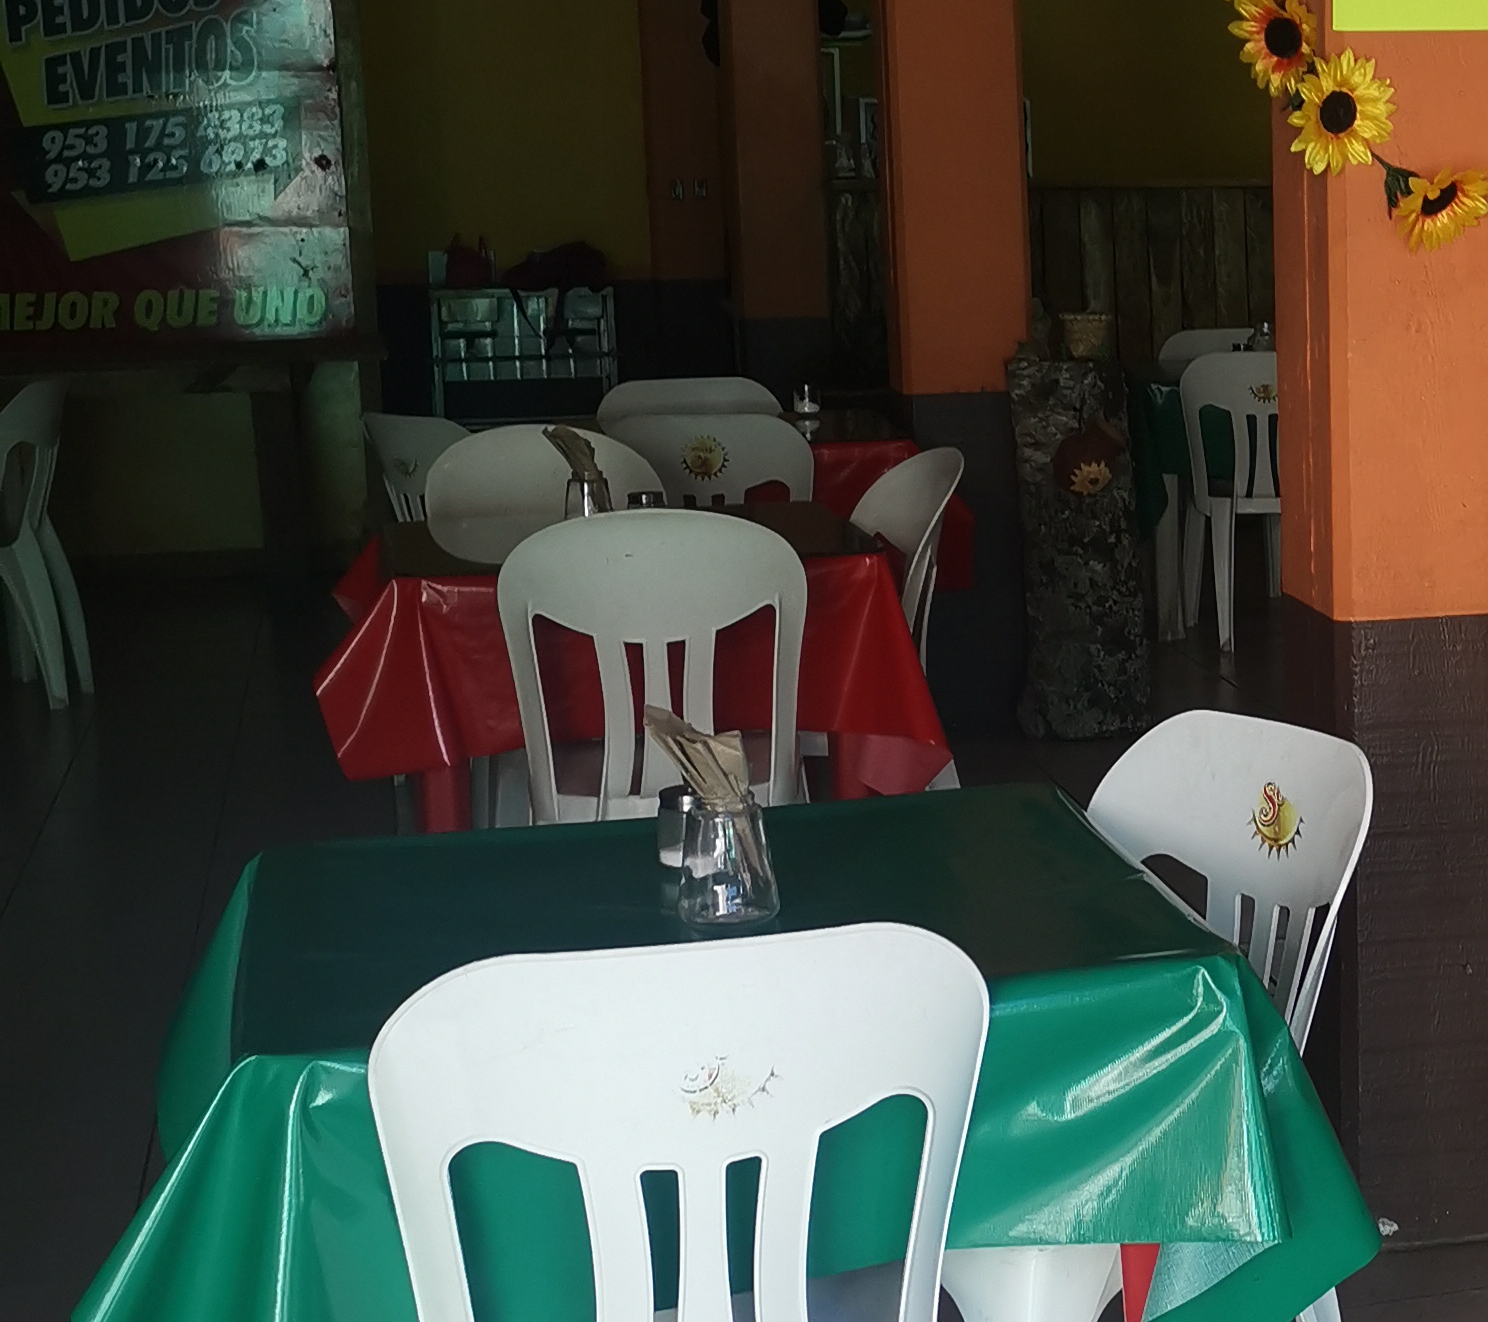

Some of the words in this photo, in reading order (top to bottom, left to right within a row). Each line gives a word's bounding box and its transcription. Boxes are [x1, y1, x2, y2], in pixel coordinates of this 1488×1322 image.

[44, 7, 257, 108] EVENTOS
[41, 126, 108, 160] 953
[126, 116, 187, 150] 175
[45, 157, 111, 194] 953
[127, 149, 189, 184] 125
[200, 137, 287, 174] 6973
[134, 288, 219, 332] QUE
[233, 285, 327, 327] UNO
